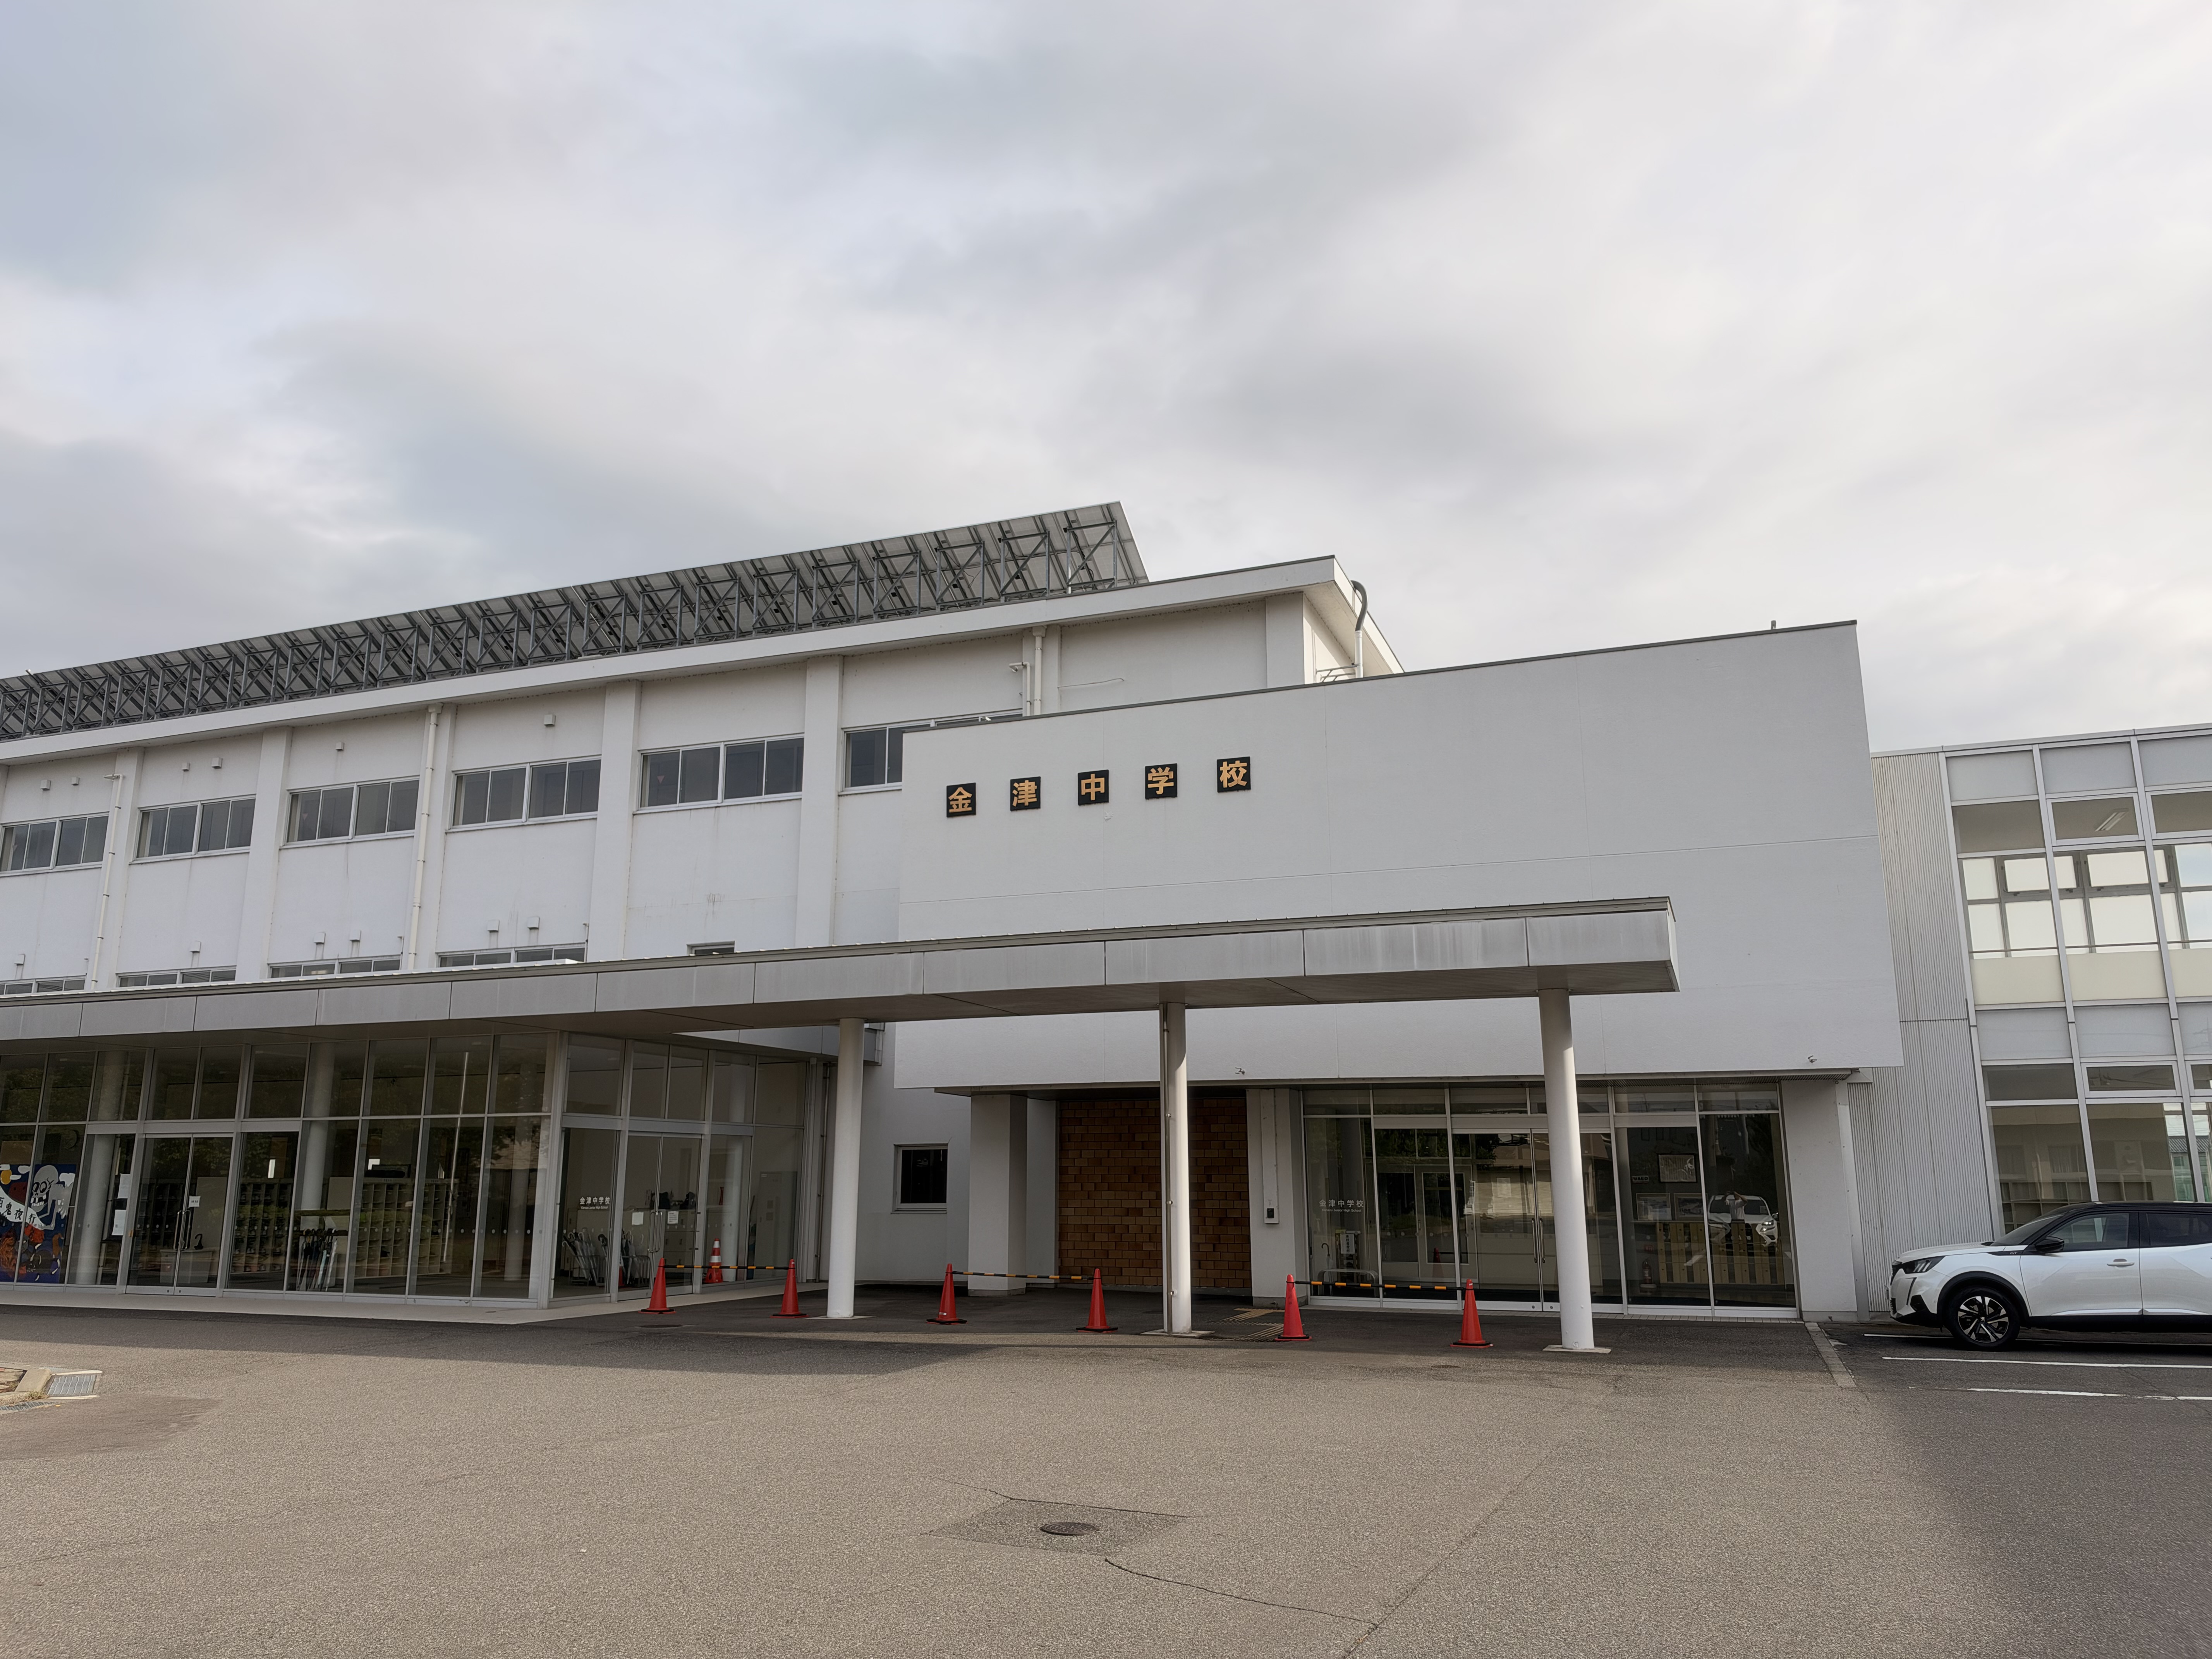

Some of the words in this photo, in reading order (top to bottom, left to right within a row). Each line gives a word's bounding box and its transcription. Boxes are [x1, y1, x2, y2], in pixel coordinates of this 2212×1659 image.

[948, 760, 1248, 813] 金津中学校
[580, 1197, 610, 1205] 金津中学校
[1319, 1199, 1364, 1207] 金津中学校
